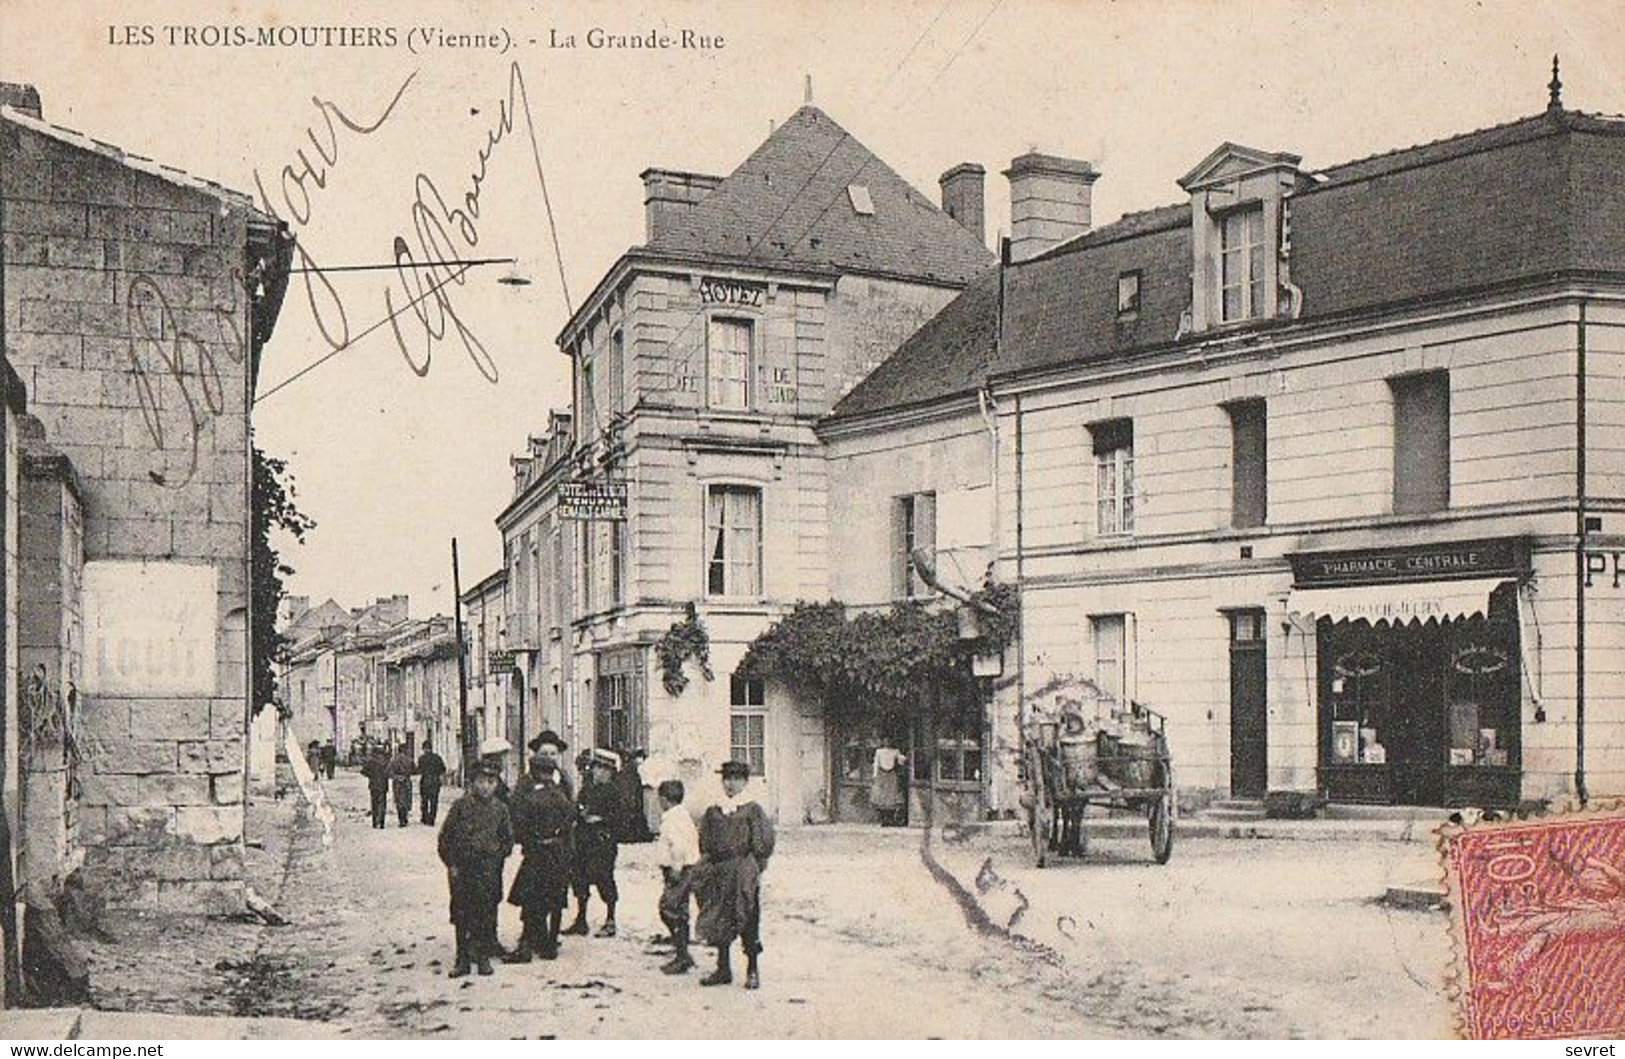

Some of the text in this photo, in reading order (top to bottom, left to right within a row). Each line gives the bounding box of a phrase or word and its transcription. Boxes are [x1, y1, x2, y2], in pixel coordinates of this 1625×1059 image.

[107, 26, 156, 47] LES
[162, 25, 399, 48] TROIS-MOUTIERS
[549, 28, 577, 50] La
[585, 27, 727, 51] Grande-Rue
[1322, 552, 1480, 576] PHARMACIE CENTRALE
